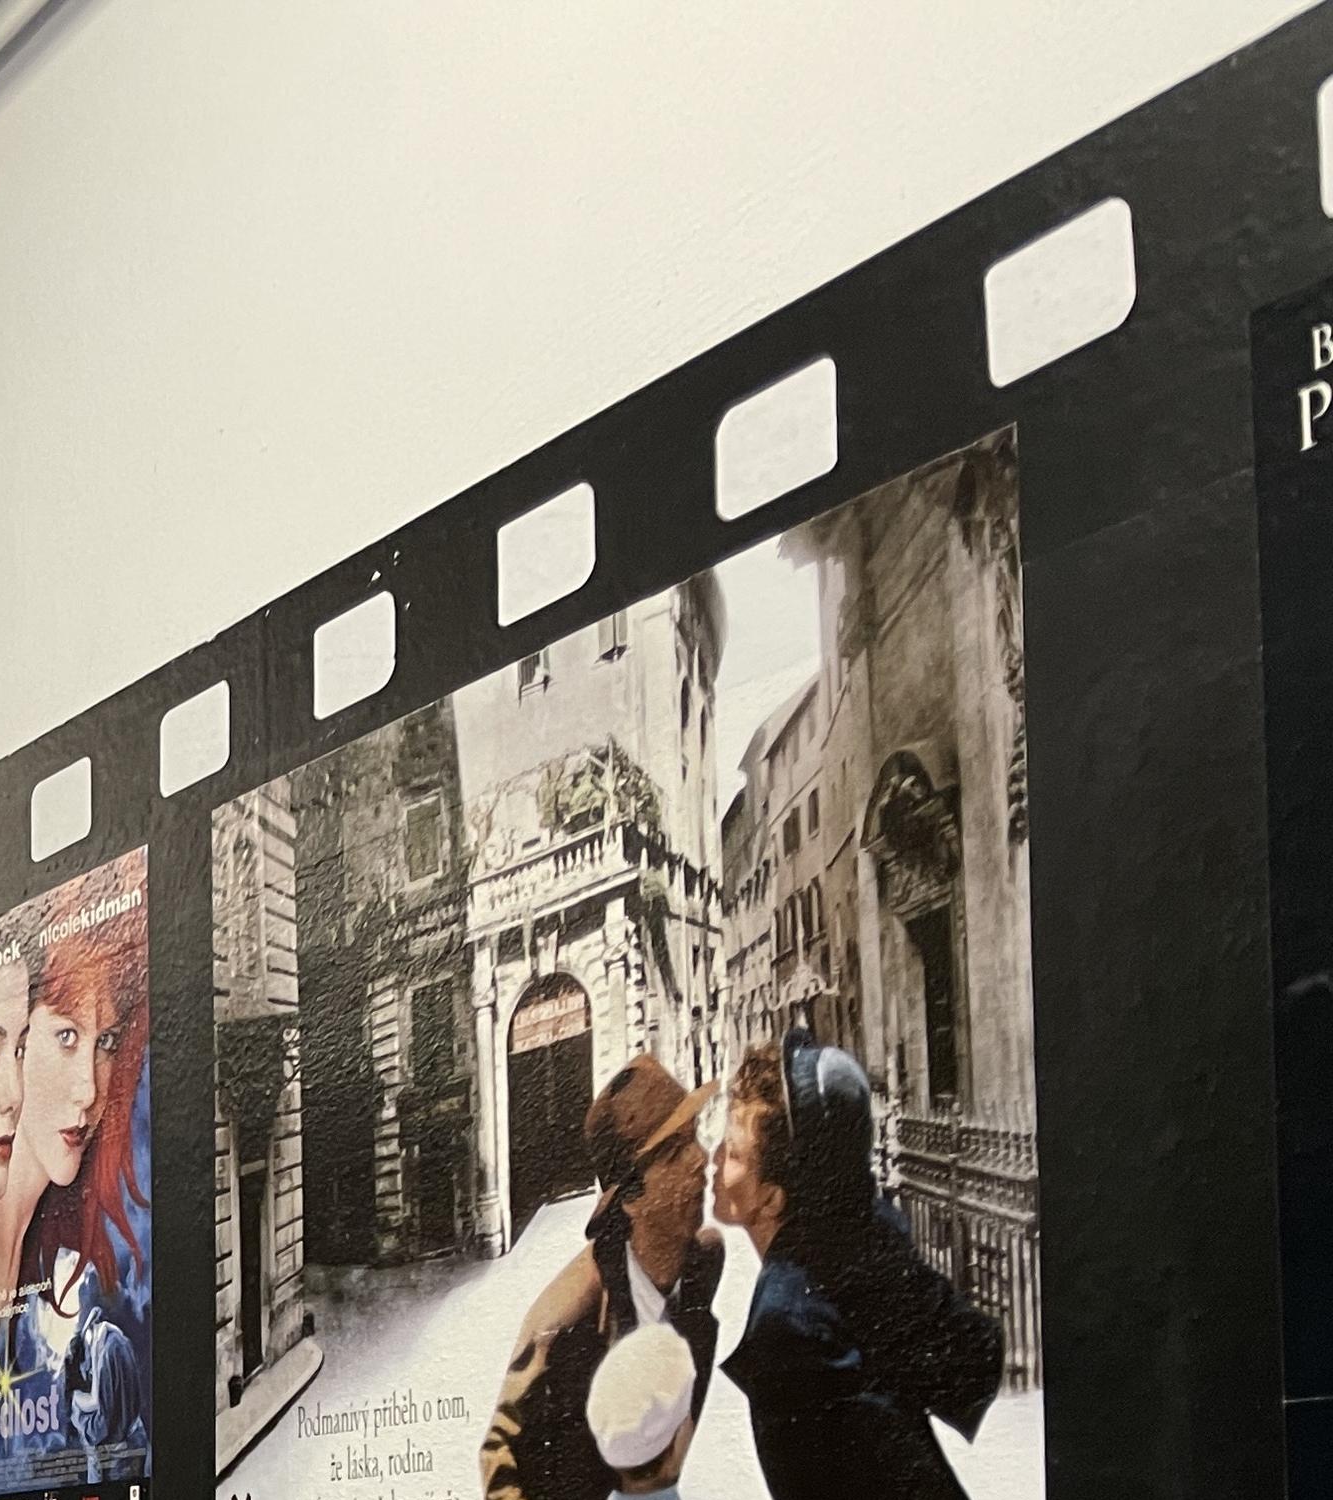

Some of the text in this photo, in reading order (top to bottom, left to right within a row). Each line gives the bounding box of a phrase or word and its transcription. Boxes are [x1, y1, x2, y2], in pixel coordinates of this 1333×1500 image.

[297, 1388, 470, 1438] Podmanivý příběh o tom,
[330, 1438, 434, 1483] že láska, rodina
